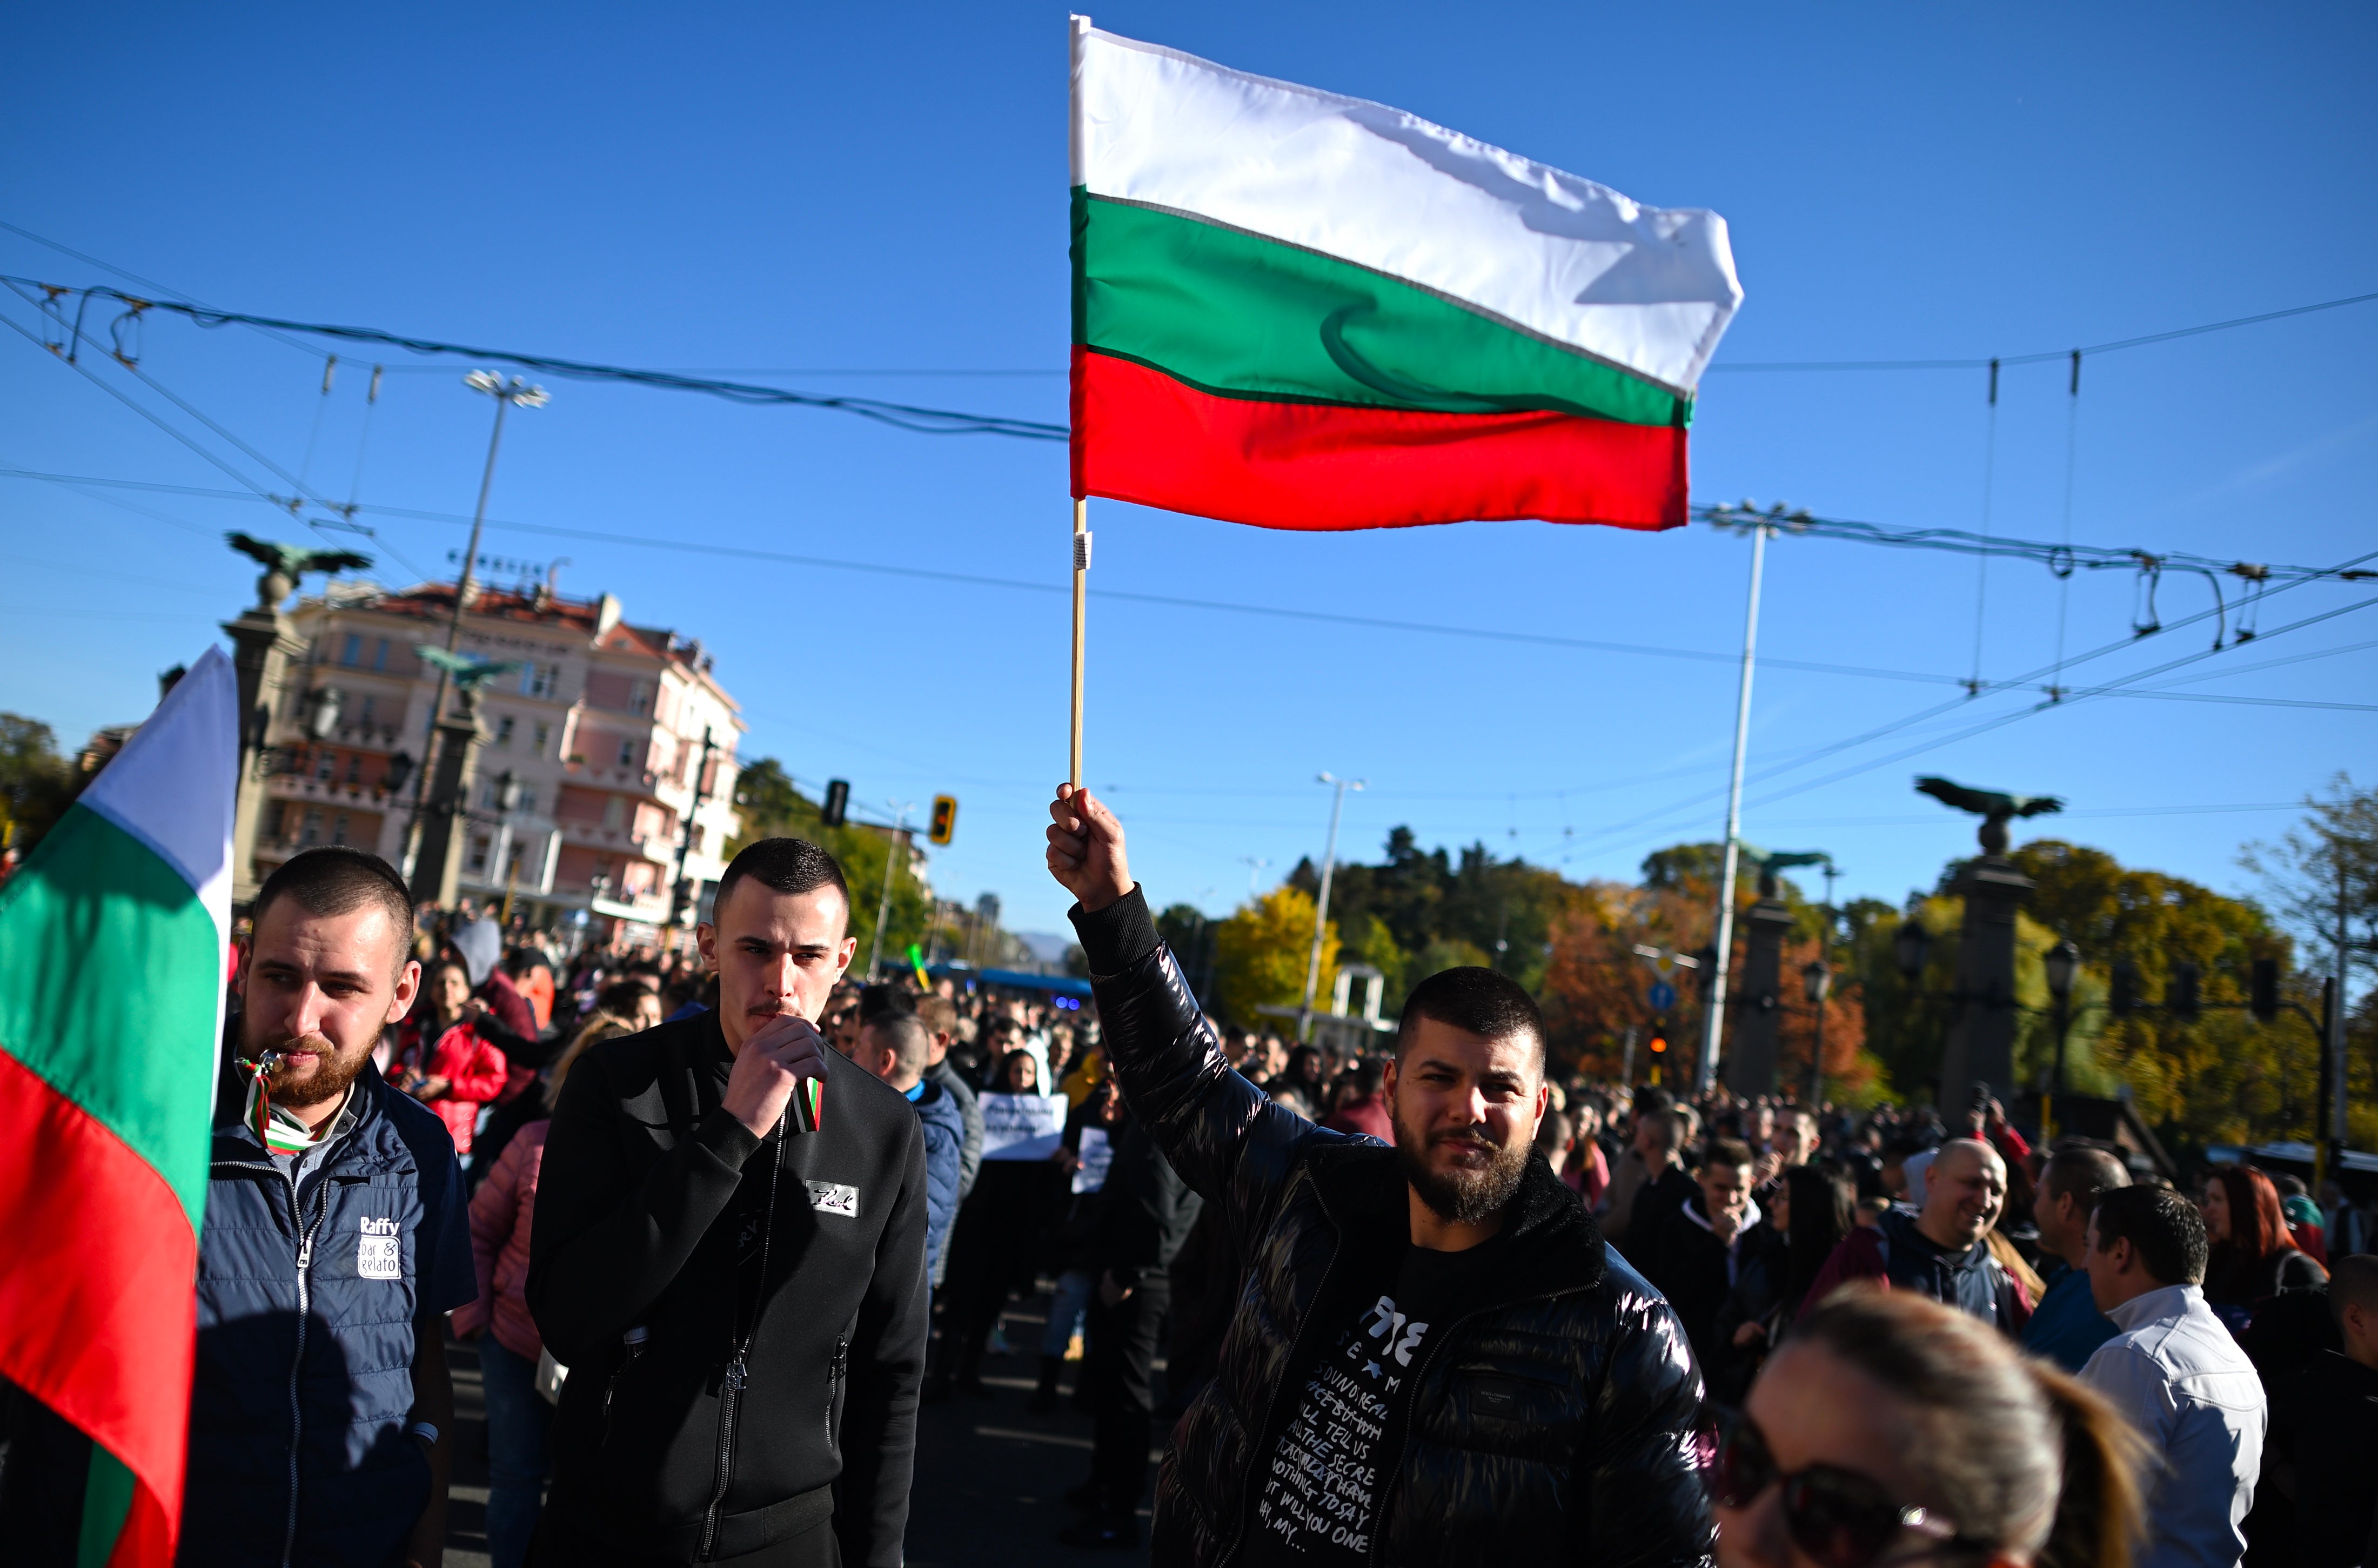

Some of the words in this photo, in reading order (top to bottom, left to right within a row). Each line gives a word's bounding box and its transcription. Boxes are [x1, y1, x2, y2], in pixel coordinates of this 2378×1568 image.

[360, 1217, 400, 1236] Raffy
[361, 1240, 377, 1256] bar
[384, 1242, 395, 1256] &
[361, 1255, 396, 1274] gelato
[1325, 1420, 1352, 1450] TELL
[1353, 1440, 1370, 1460] US
[1301, 1427, 1334, 1458] THE
[1328, 1453, 1376, 1486] SECRE
[1280, 1491, 1305, 1521] WILL
[1304, 1508, 1331, 1535] YOU
[1331, 1525, 1369, 1554] ONE
